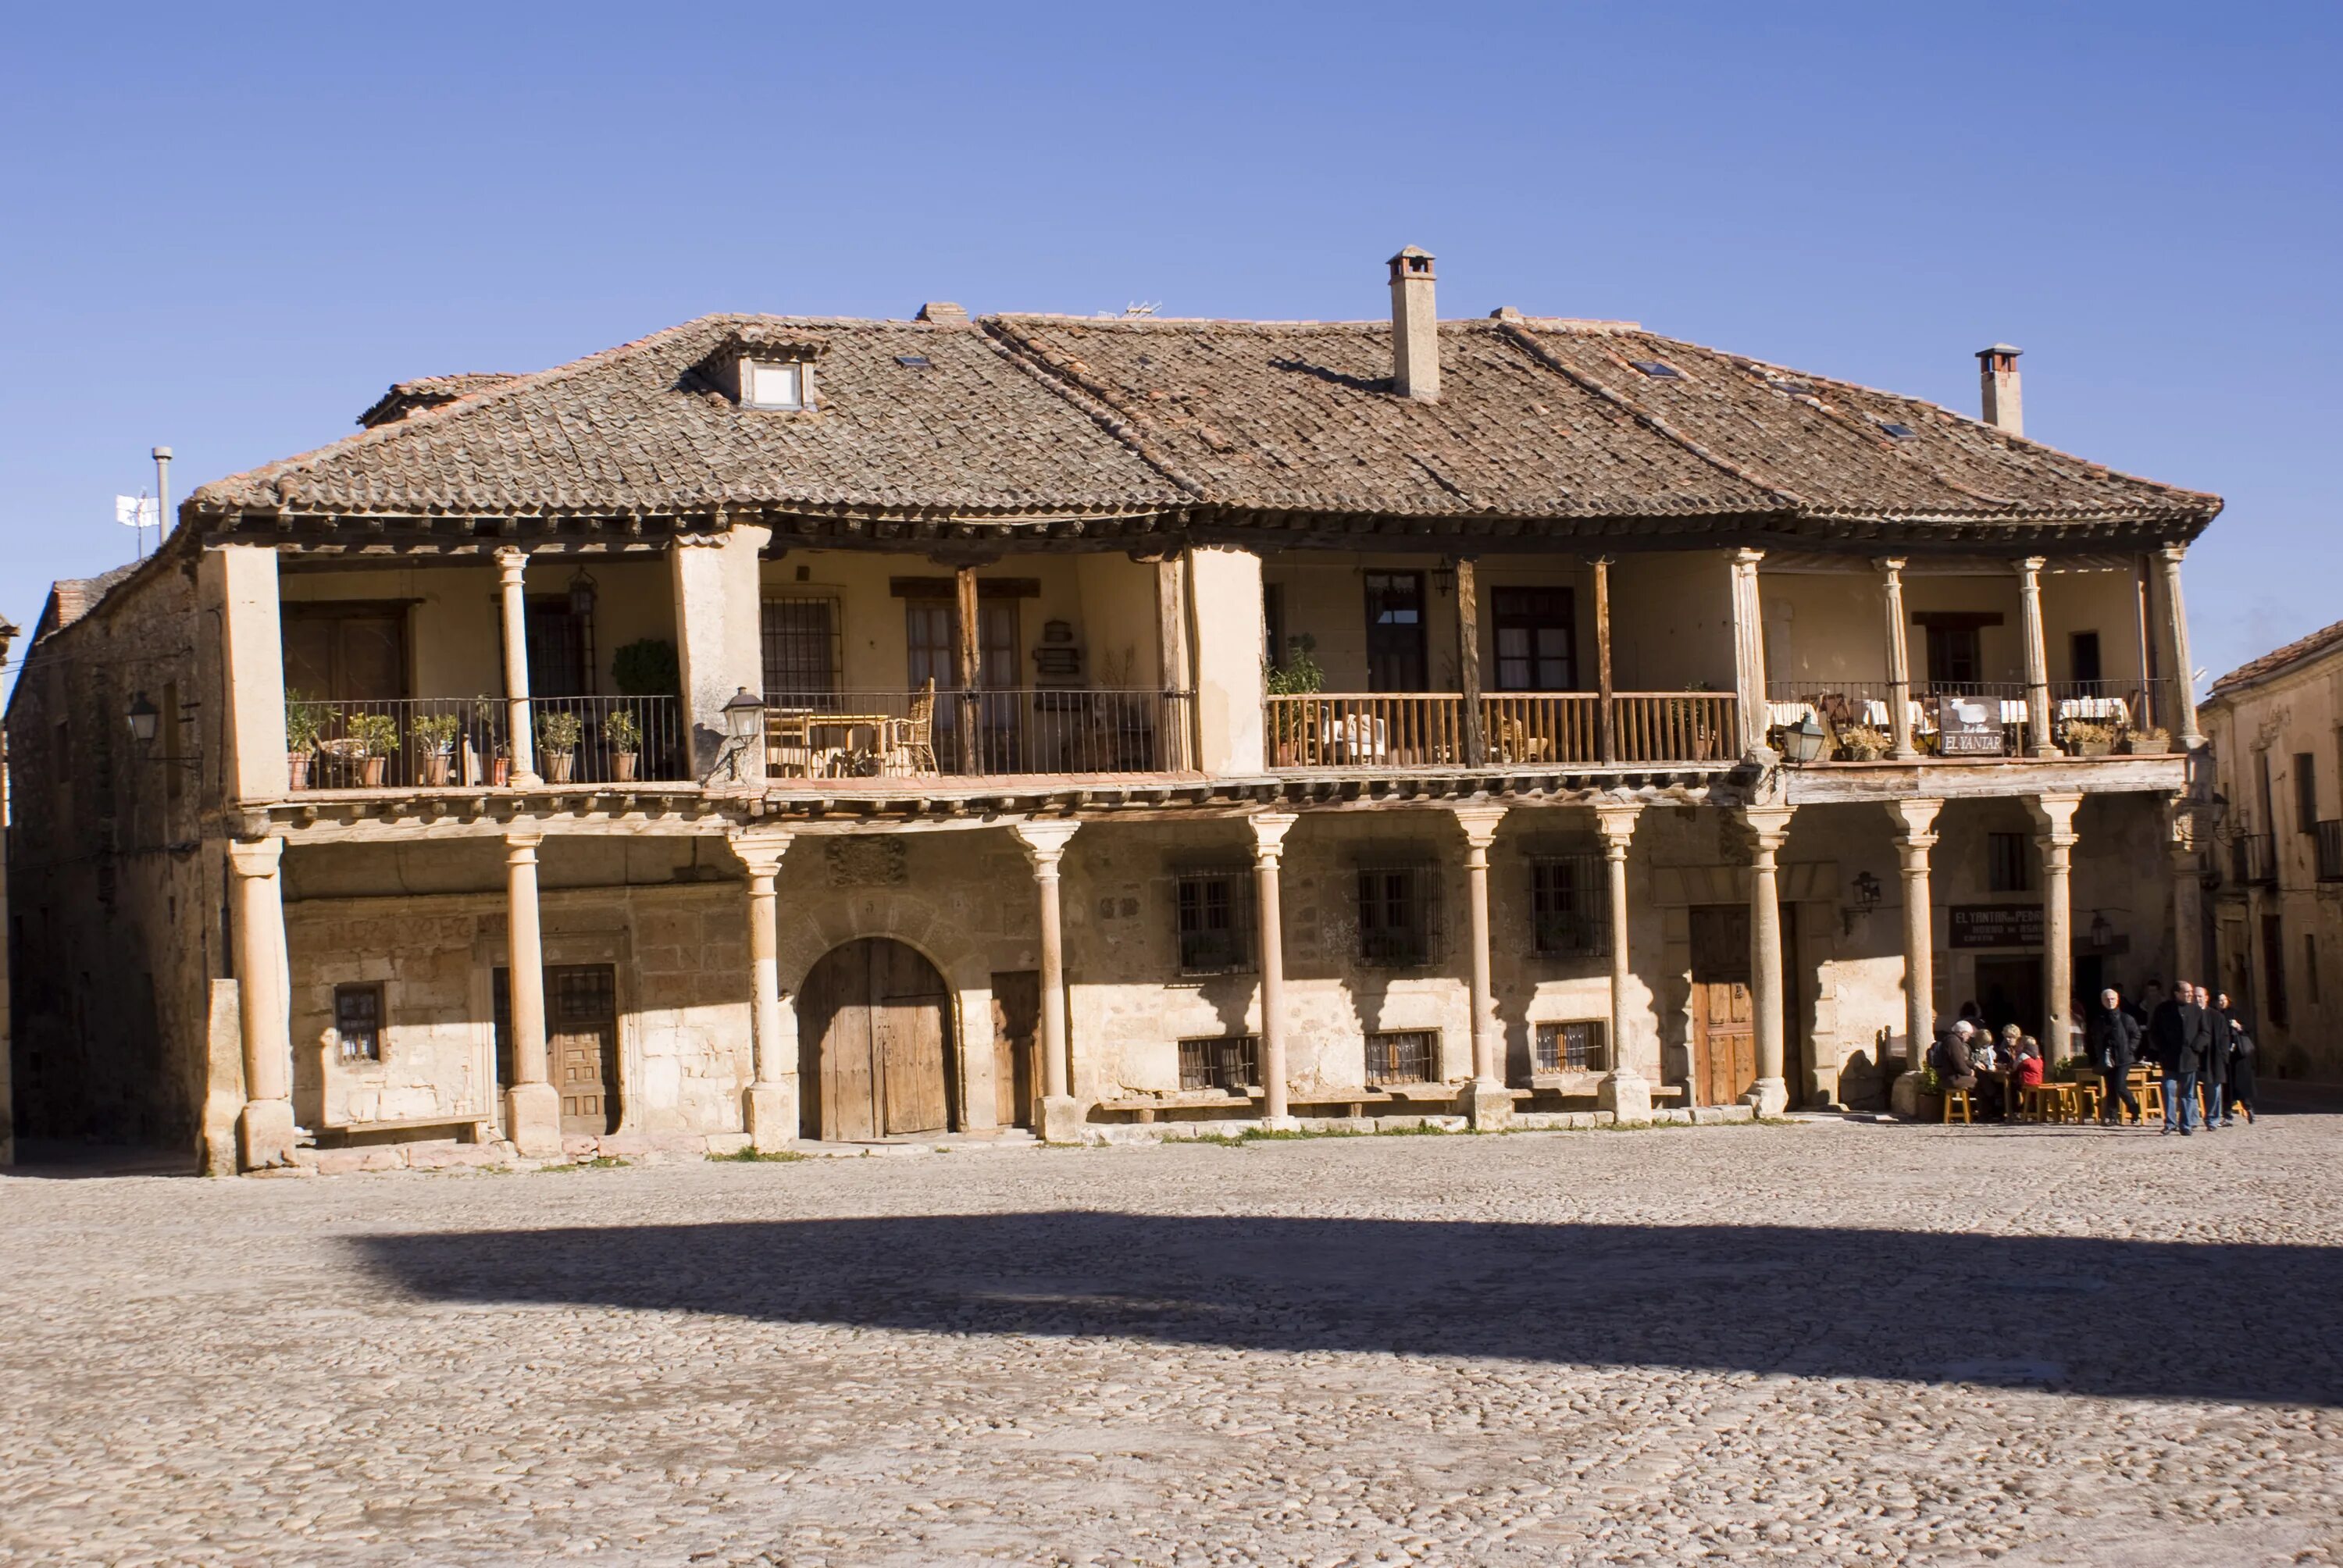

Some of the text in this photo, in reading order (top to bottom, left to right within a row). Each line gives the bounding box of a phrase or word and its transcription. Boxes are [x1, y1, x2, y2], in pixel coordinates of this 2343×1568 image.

[1945, 736, 2002, 750] EL YANTAR
[1956, 911, 1968, 924] EL
[1969, 911, 2007, 923] YANTAR
